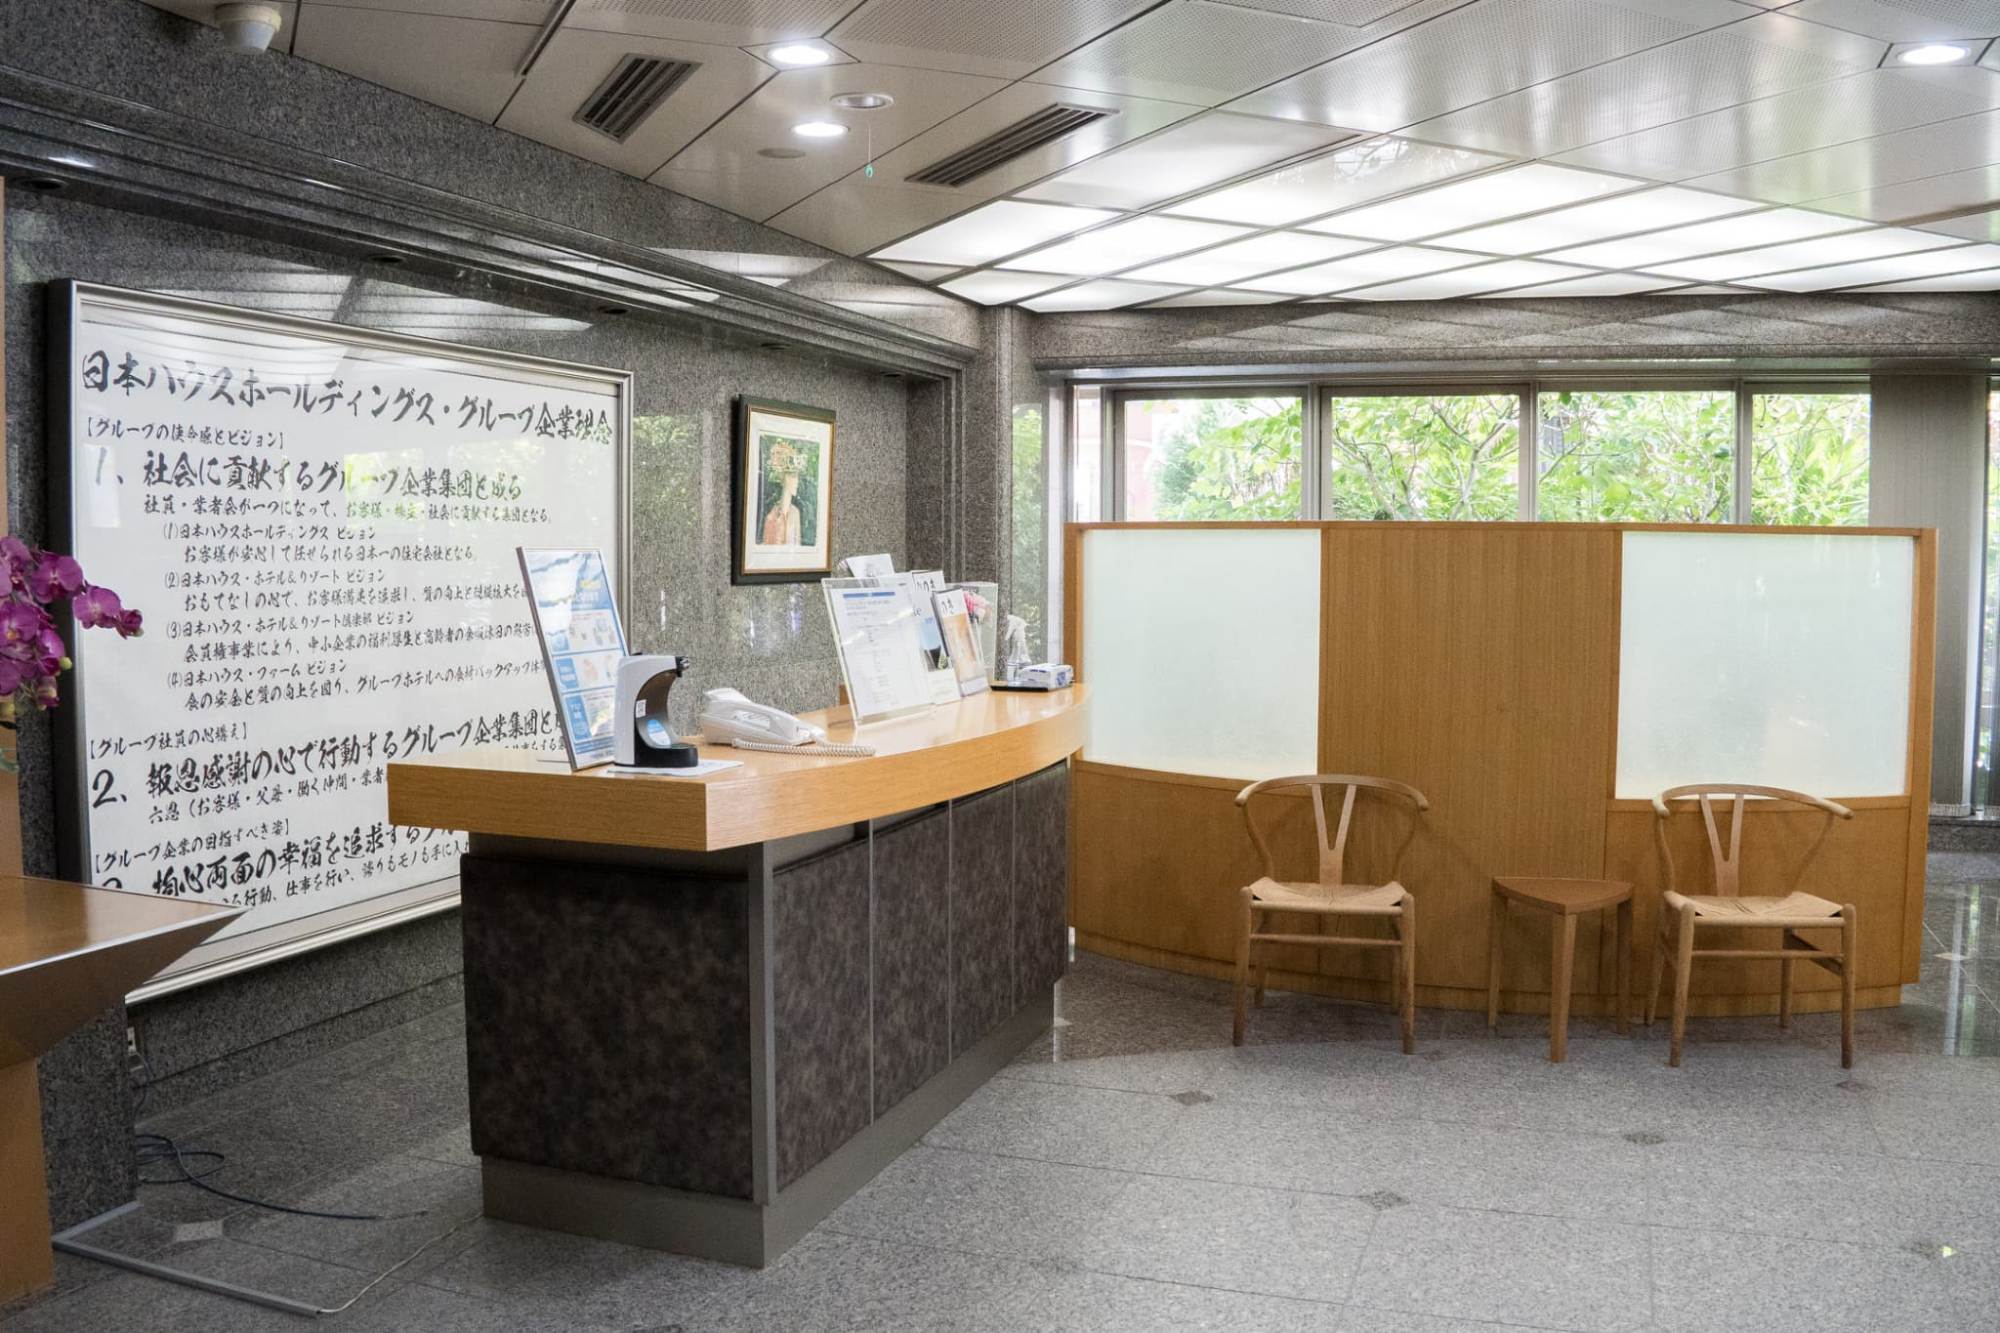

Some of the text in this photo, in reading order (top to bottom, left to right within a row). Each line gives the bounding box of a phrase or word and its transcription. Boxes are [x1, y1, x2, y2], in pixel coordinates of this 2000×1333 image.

[347, 569, 384, 584] ビジョン
[377, 610, 414, 626] ビジョン
[307, 659, 347, 677] ビジョン
[153, 820, 453, 897] 物心両面の幸福を追求する
